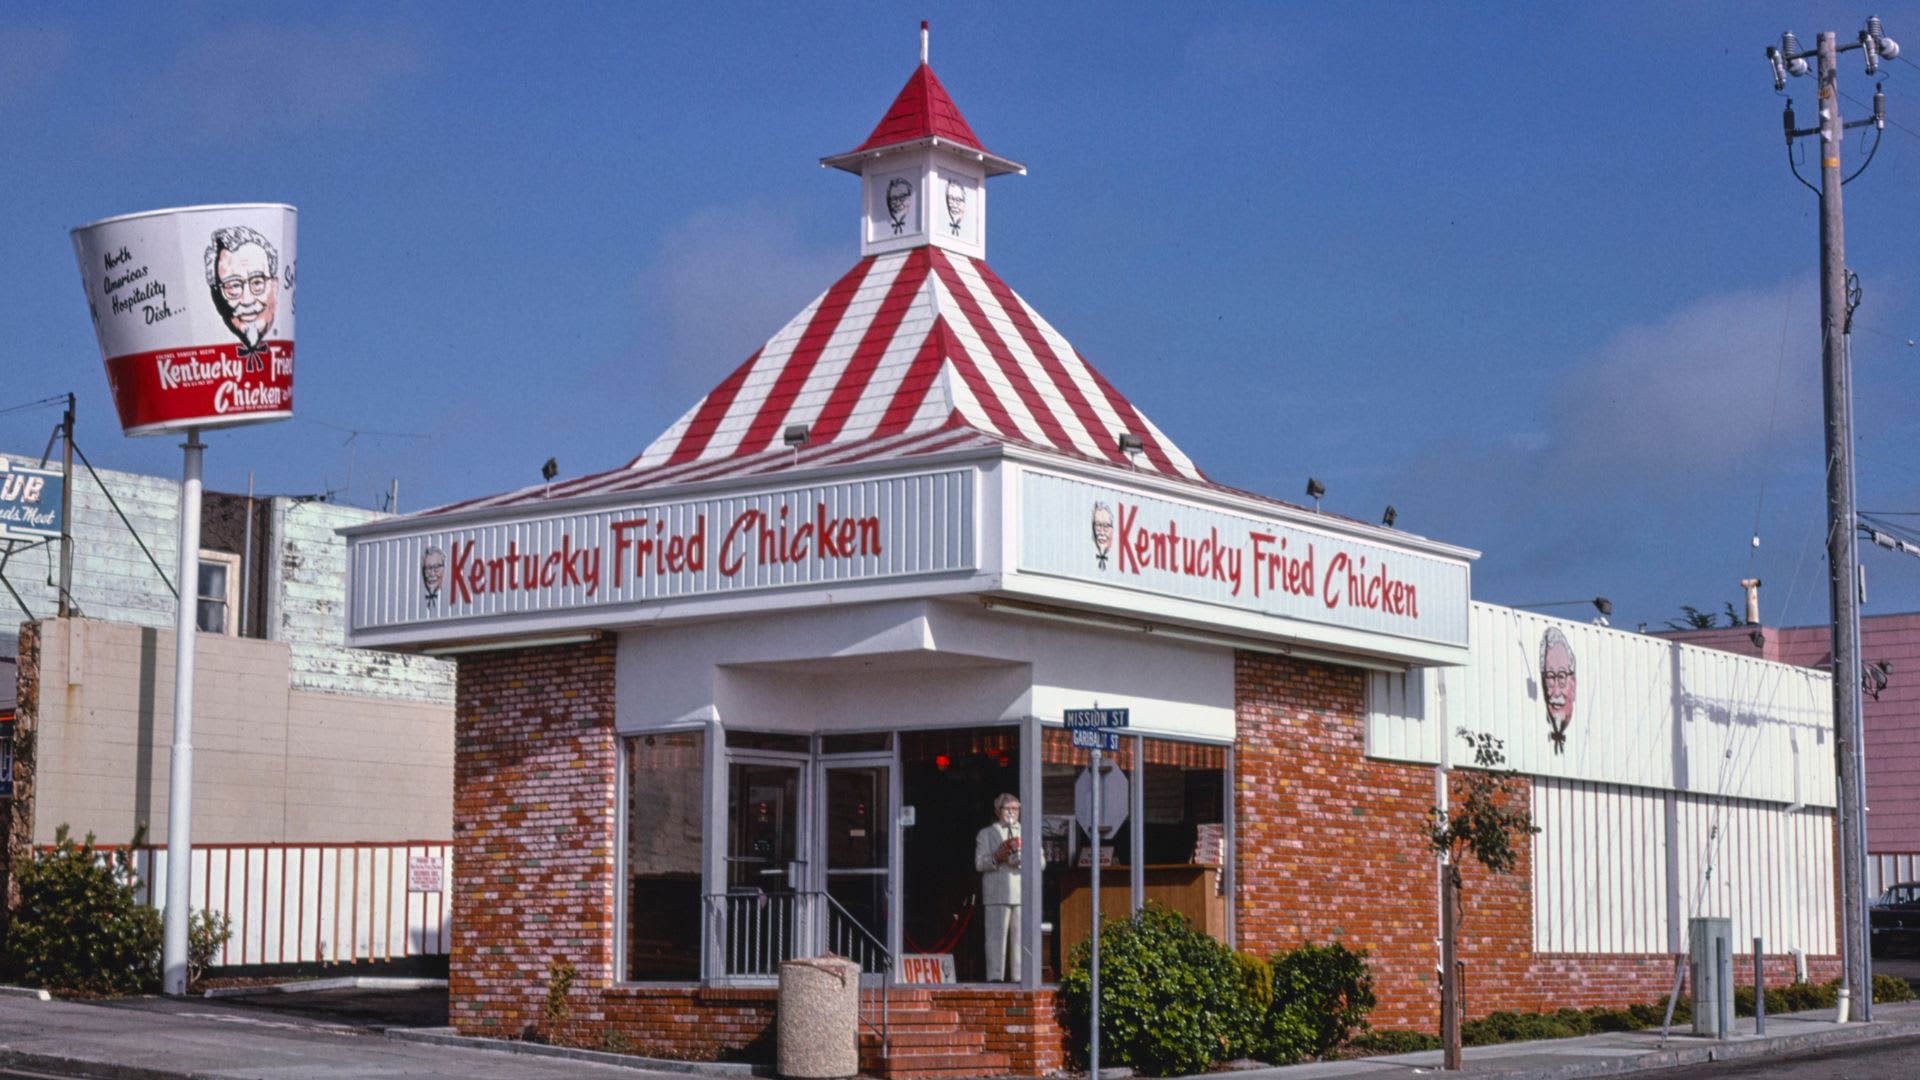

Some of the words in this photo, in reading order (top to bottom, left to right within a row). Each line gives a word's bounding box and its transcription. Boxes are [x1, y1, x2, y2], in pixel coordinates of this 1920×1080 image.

[104, 246, 132, 271] North
[112, 280, 166, 316] Hospitality
[156, 352, 243, 390] Kentucky
[214, 380, 281, 413] Chicken
[22, 506, 55, 527] Meet
[450, 533, 600, 604] Kentucky
[611, 514, 704, 588] Fried
[719, 502, 882, 577] Chicken
[1118, 502, 1242, 597] Kentucky
[1249, 531, 1315, 598] Fried
[1323, 551, 1419, 619] Chicken
[1067, 711, 1108, 727] MISSION
[1111, 710, 1125, 726] ST
[1110, 734, 1119, 750] ST
[904, 958, 941, 984] OPEN
